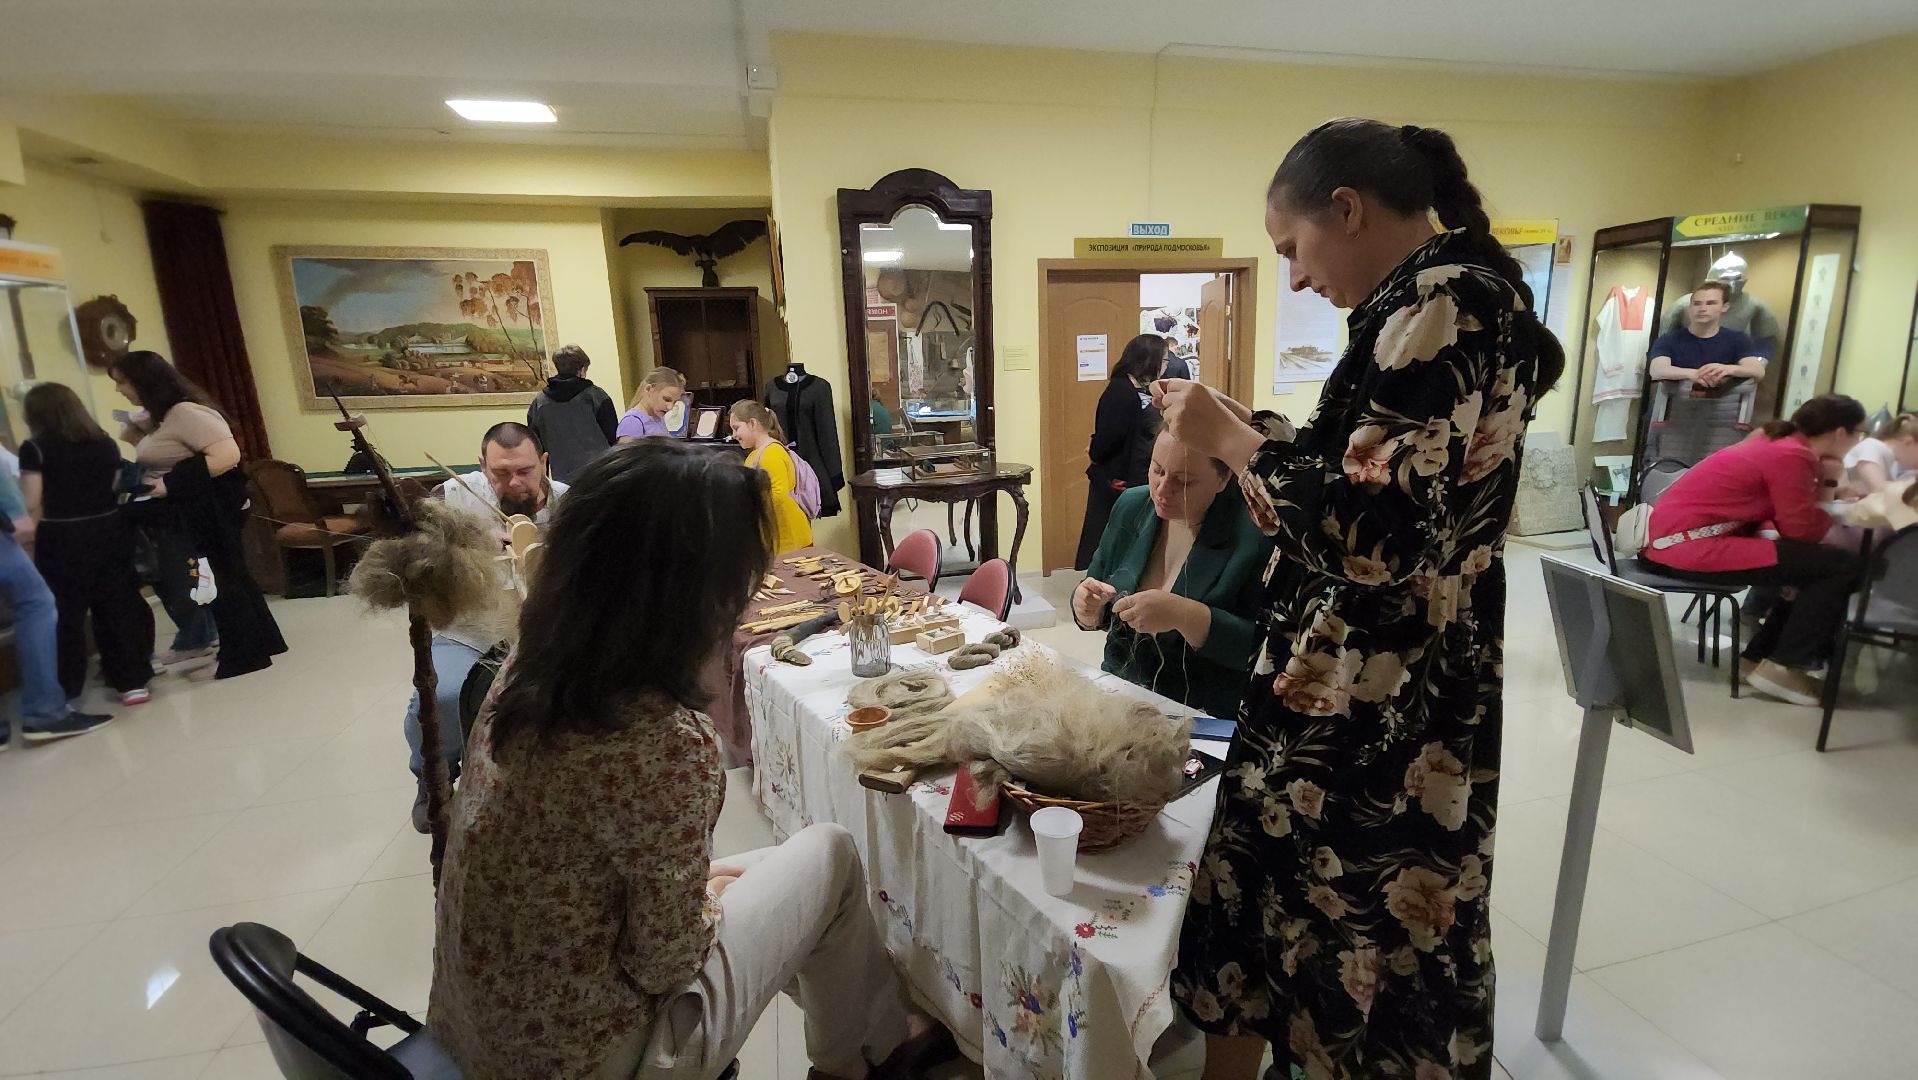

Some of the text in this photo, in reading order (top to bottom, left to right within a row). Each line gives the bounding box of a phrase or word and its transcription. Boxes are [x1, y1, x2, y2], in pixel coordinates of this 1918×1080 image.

[1694, 213, 1755, 227] СРЕДНИЕ
[1132, 224, 1168, 235] ВЫХОД
[1088, 244, 1129, 252] ЭКСПОЗИЦИЯ
[1131, 244, 1162, 252] «ПРИРОДА
